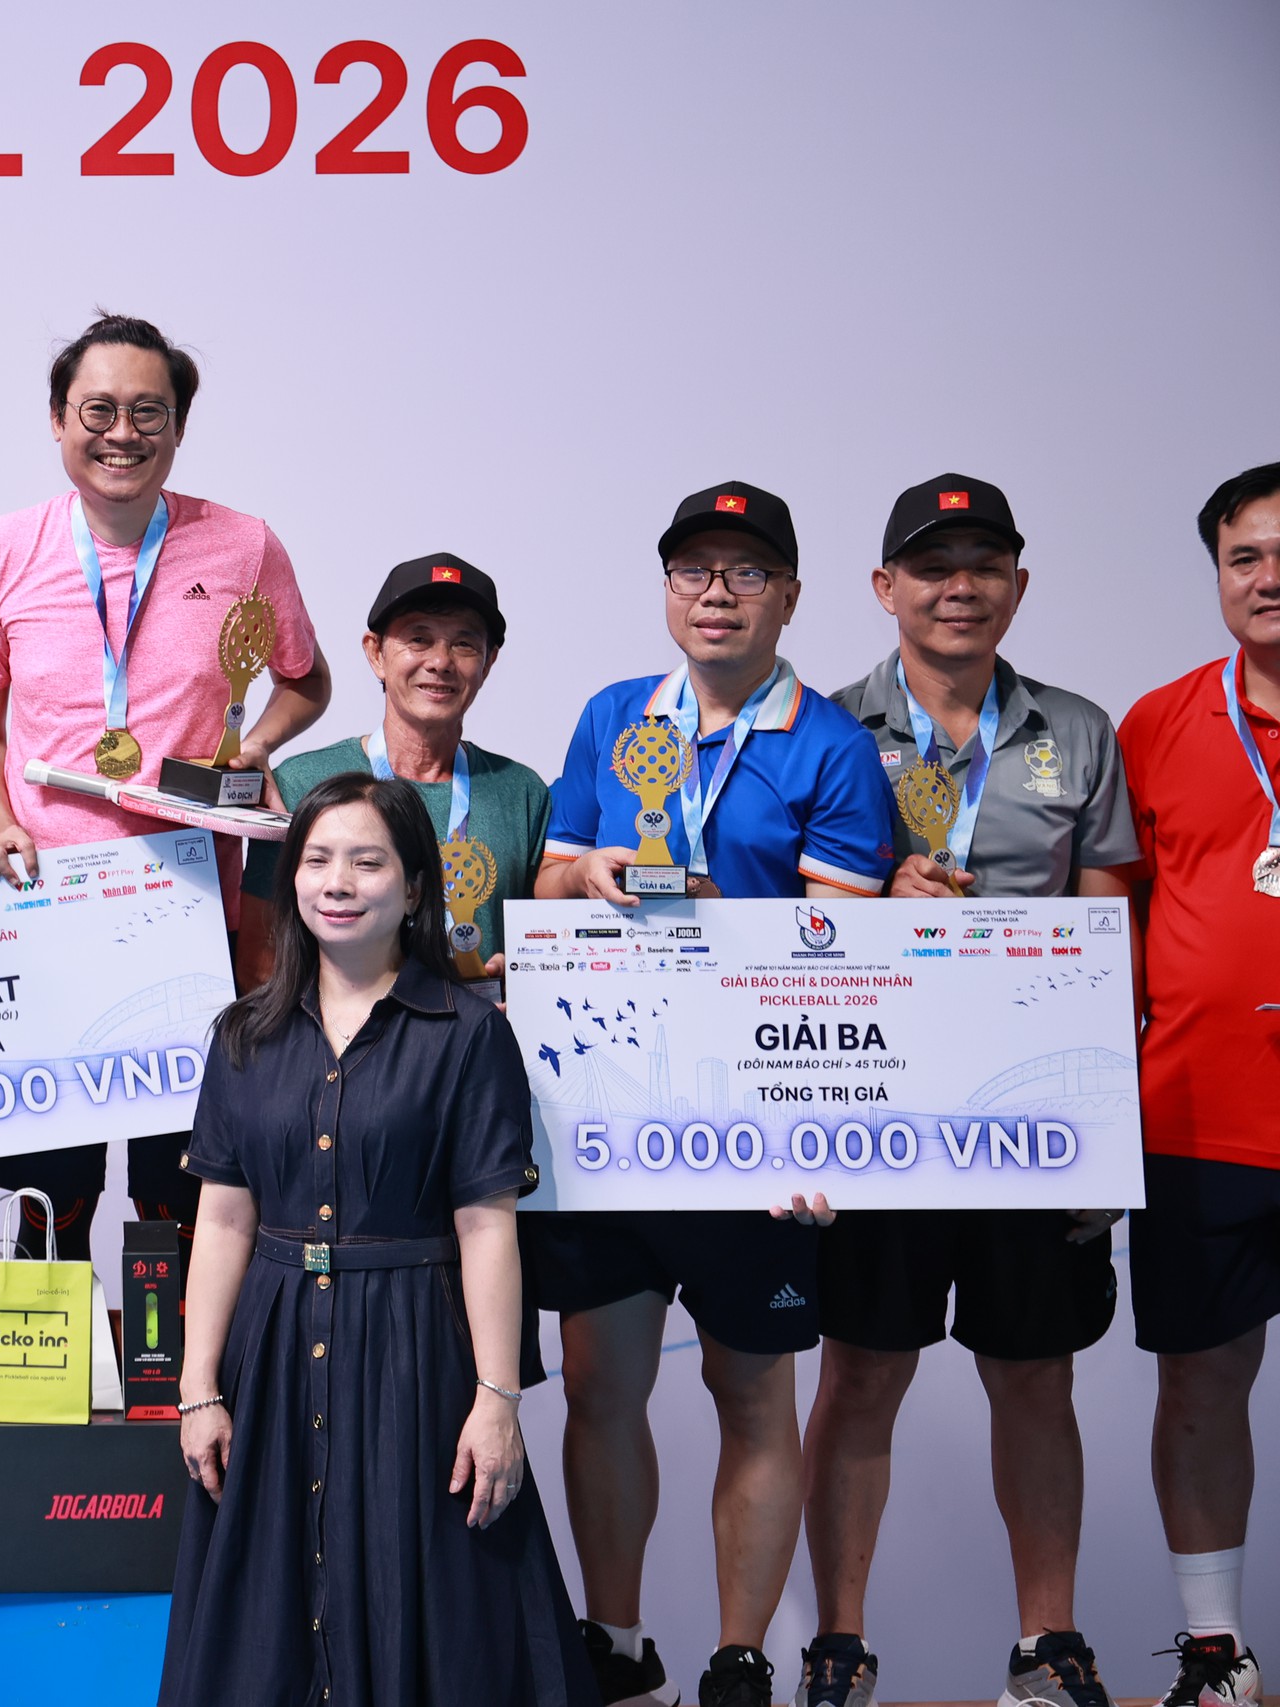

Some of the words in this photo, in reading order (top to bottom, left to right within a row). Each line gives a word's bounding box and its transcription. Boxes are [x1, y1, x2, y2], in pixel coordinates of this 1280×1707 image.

[79, 38, 529, 178] 2026
[158, 808, 182, 820] PRO
[61, 874, 88, 886] HTV
[678, 928, 700, 938] JOOLA
[914, 928, 946, 939] VTV9
[963, 928, 994, 938] HTV
[1028, 929, 1042, 938] Play
[720, 974, 747, 988] GIẢI
[751, 974, 778, 988] BÁO
[782, 974, 806, 987] CHÍ
[809, 977, 817, 987] &
[820, 977, 869, 987] DOANH
[873, 973, 913, 987] NHÂN
[760, 995, 840, 1006] PICKLEBALL
[844, 995, 878, 1006] 2026
[755, 1014, 827, 1051] GIẢI
[838, 1024, 887, 1051] BA
[744, 1058, 764, 1069] ĐÔI
[767, 1060, 793, 1069] NAM
[795, 1058, 820, 1069] BÁO
[822, 1057, 842, 1069] CHÍ
[855, 1060, 870, 1069] 45
[873, 1057, 899, 1069] TUỔI
[74, 1046, 206, 1105] VND
[757, 1082, 813, 1101] TỔNG
[818, 1087, 849, 1105] TRỊ
[854, 1082, 889, 1101] GIÁ
[574, 1120, 919, 1171] 5.000.000
[938, 1121, 1079, 1168] VND
[770, 1297, 806, 1308] adidas
[44, 1494, 164, 1520] JOGARBOLA
